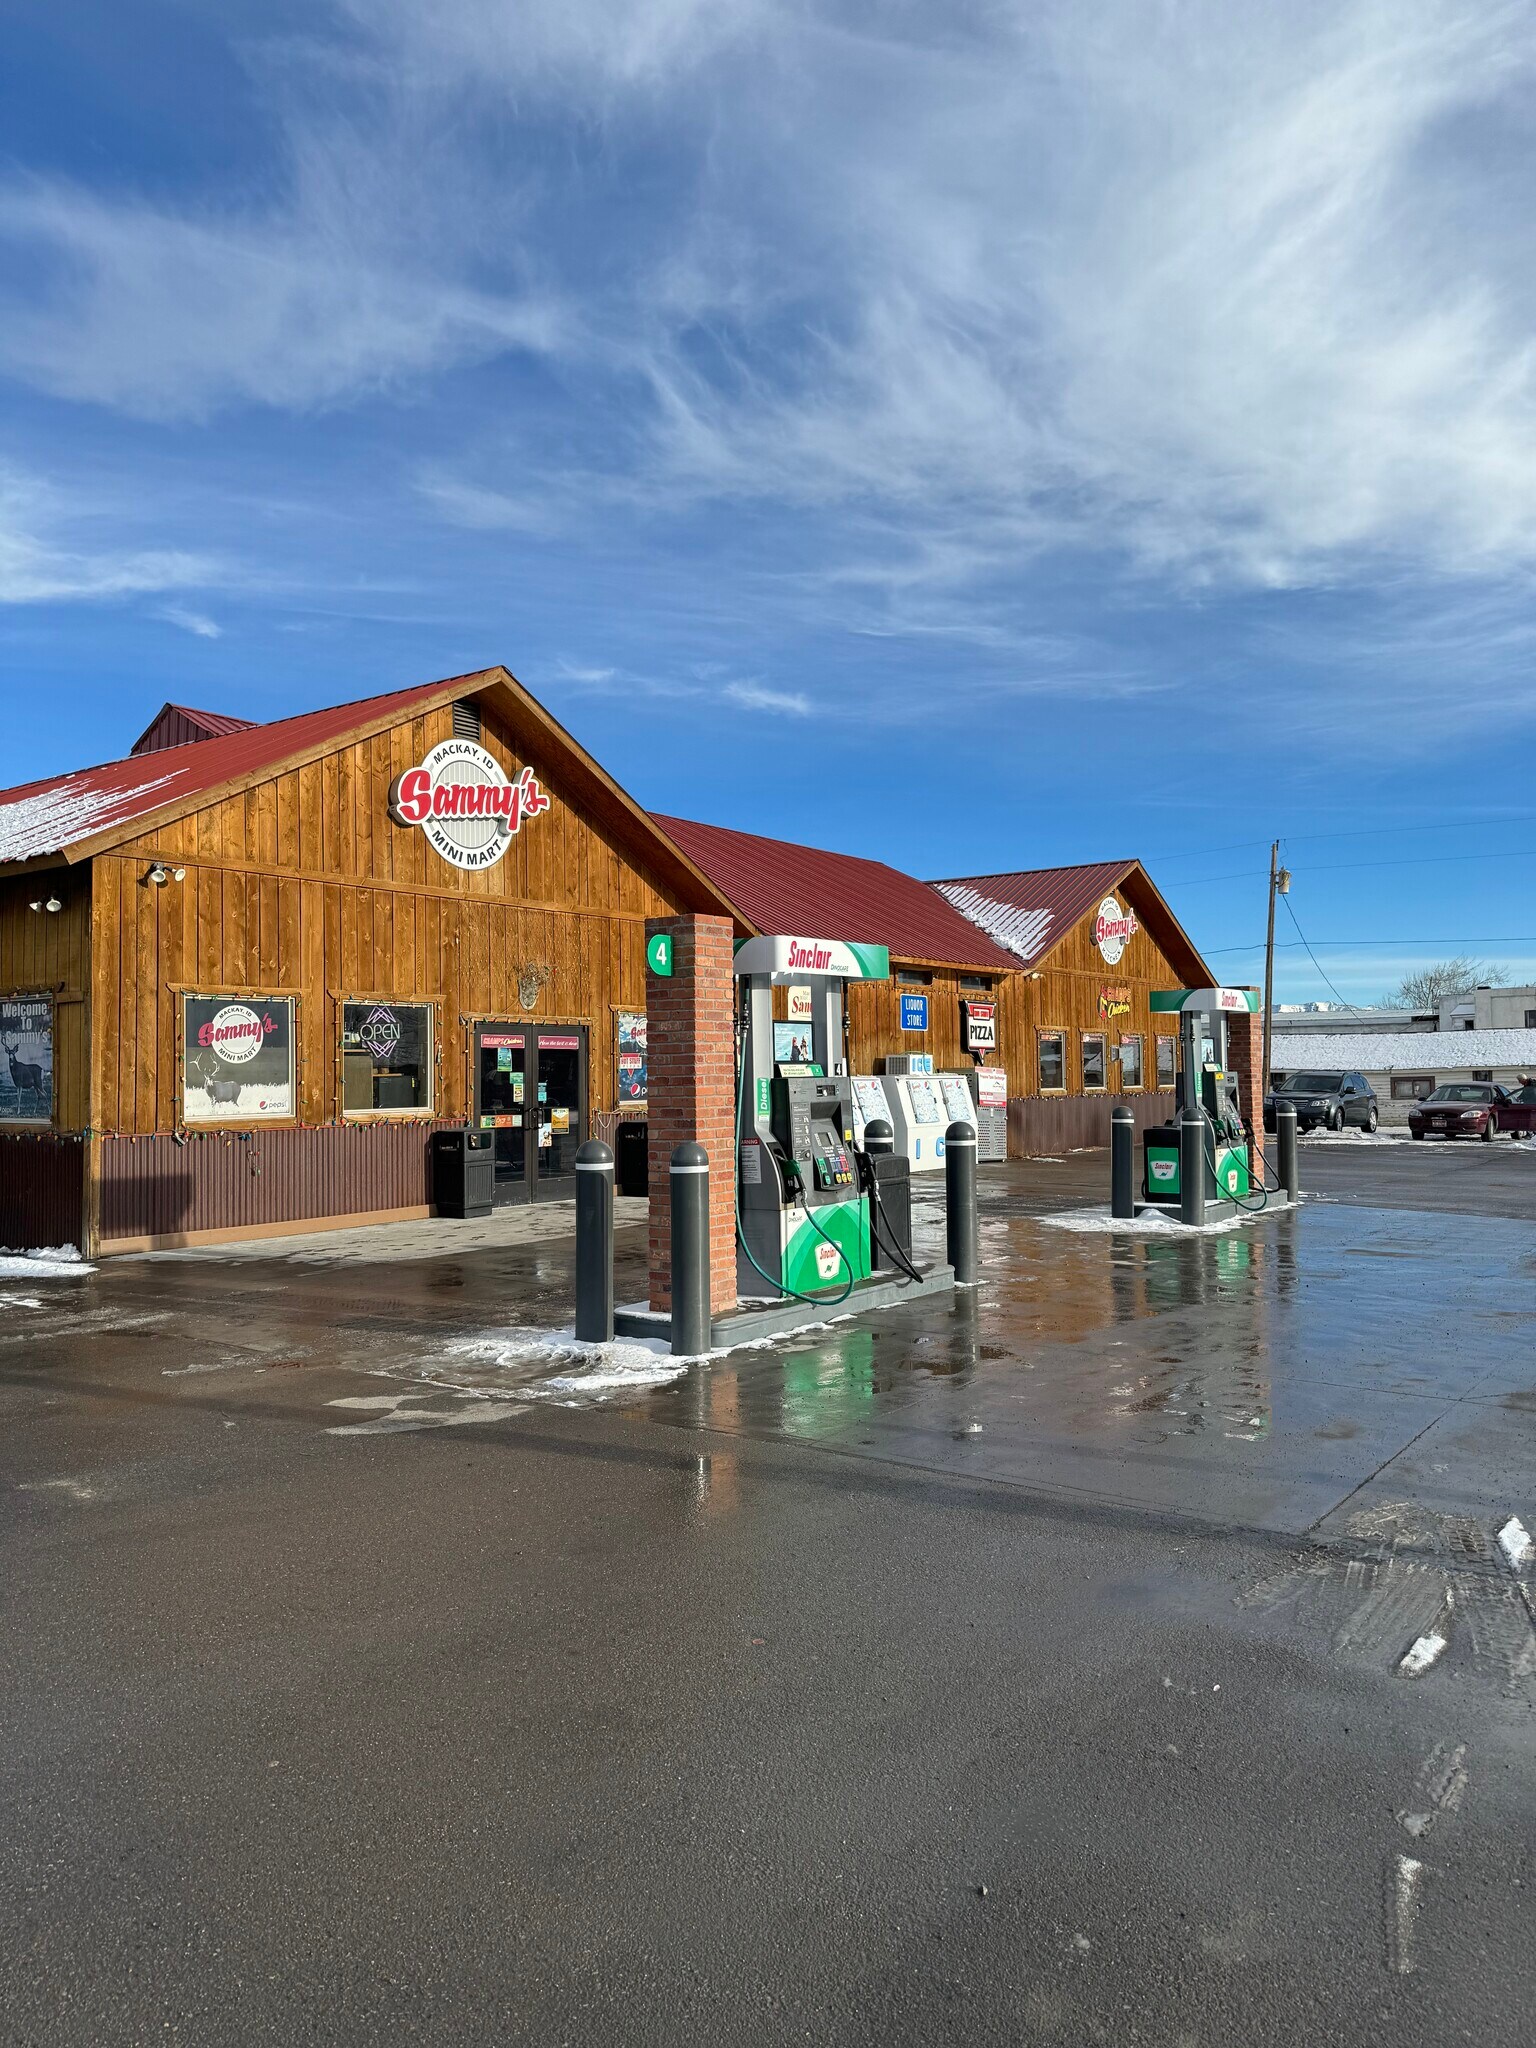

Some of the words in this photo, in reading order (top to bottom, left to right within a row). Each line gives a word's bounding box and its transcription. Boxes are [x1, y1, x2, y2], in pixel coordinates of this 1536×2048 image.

[433, 744, 480, 765] MACKAY,
[482, 755, 494, 770] ID
[398, 768, 549, 832] Sammy's
[431, 830, 463, 863] MINI
[467, 839, 502, 865] MART
[1096, 908, 1137, 943] Sammy's
[655, 942, 668, 966] 4
[788, 940, 833, 970] Sinclair
[905, 998, 924, 1011] LIQUOR
[1221, 990, 1238, 1007] Sinclair
[2, 1003, 48, 1018] Welcome
[20, 1016, 33, 1030] To
[906, 1014, 923, 1026] STORE
[5, 1029, 48, 1045] Sammy's
[198, 1012, 279, 1047] Sammy's
[359, 1023, 400, 1040] OPEN
[969, 1024, 994, 1041] PIZZA
[218, 1048, 236, 1061] MINI
[236, 1046, 257, 1061] MART
[911, 1057, 931, 1072] ICE
[760, 1078, 768, 1110] Diesel
[1155, 1162, 1173, 1170] Sinclair
